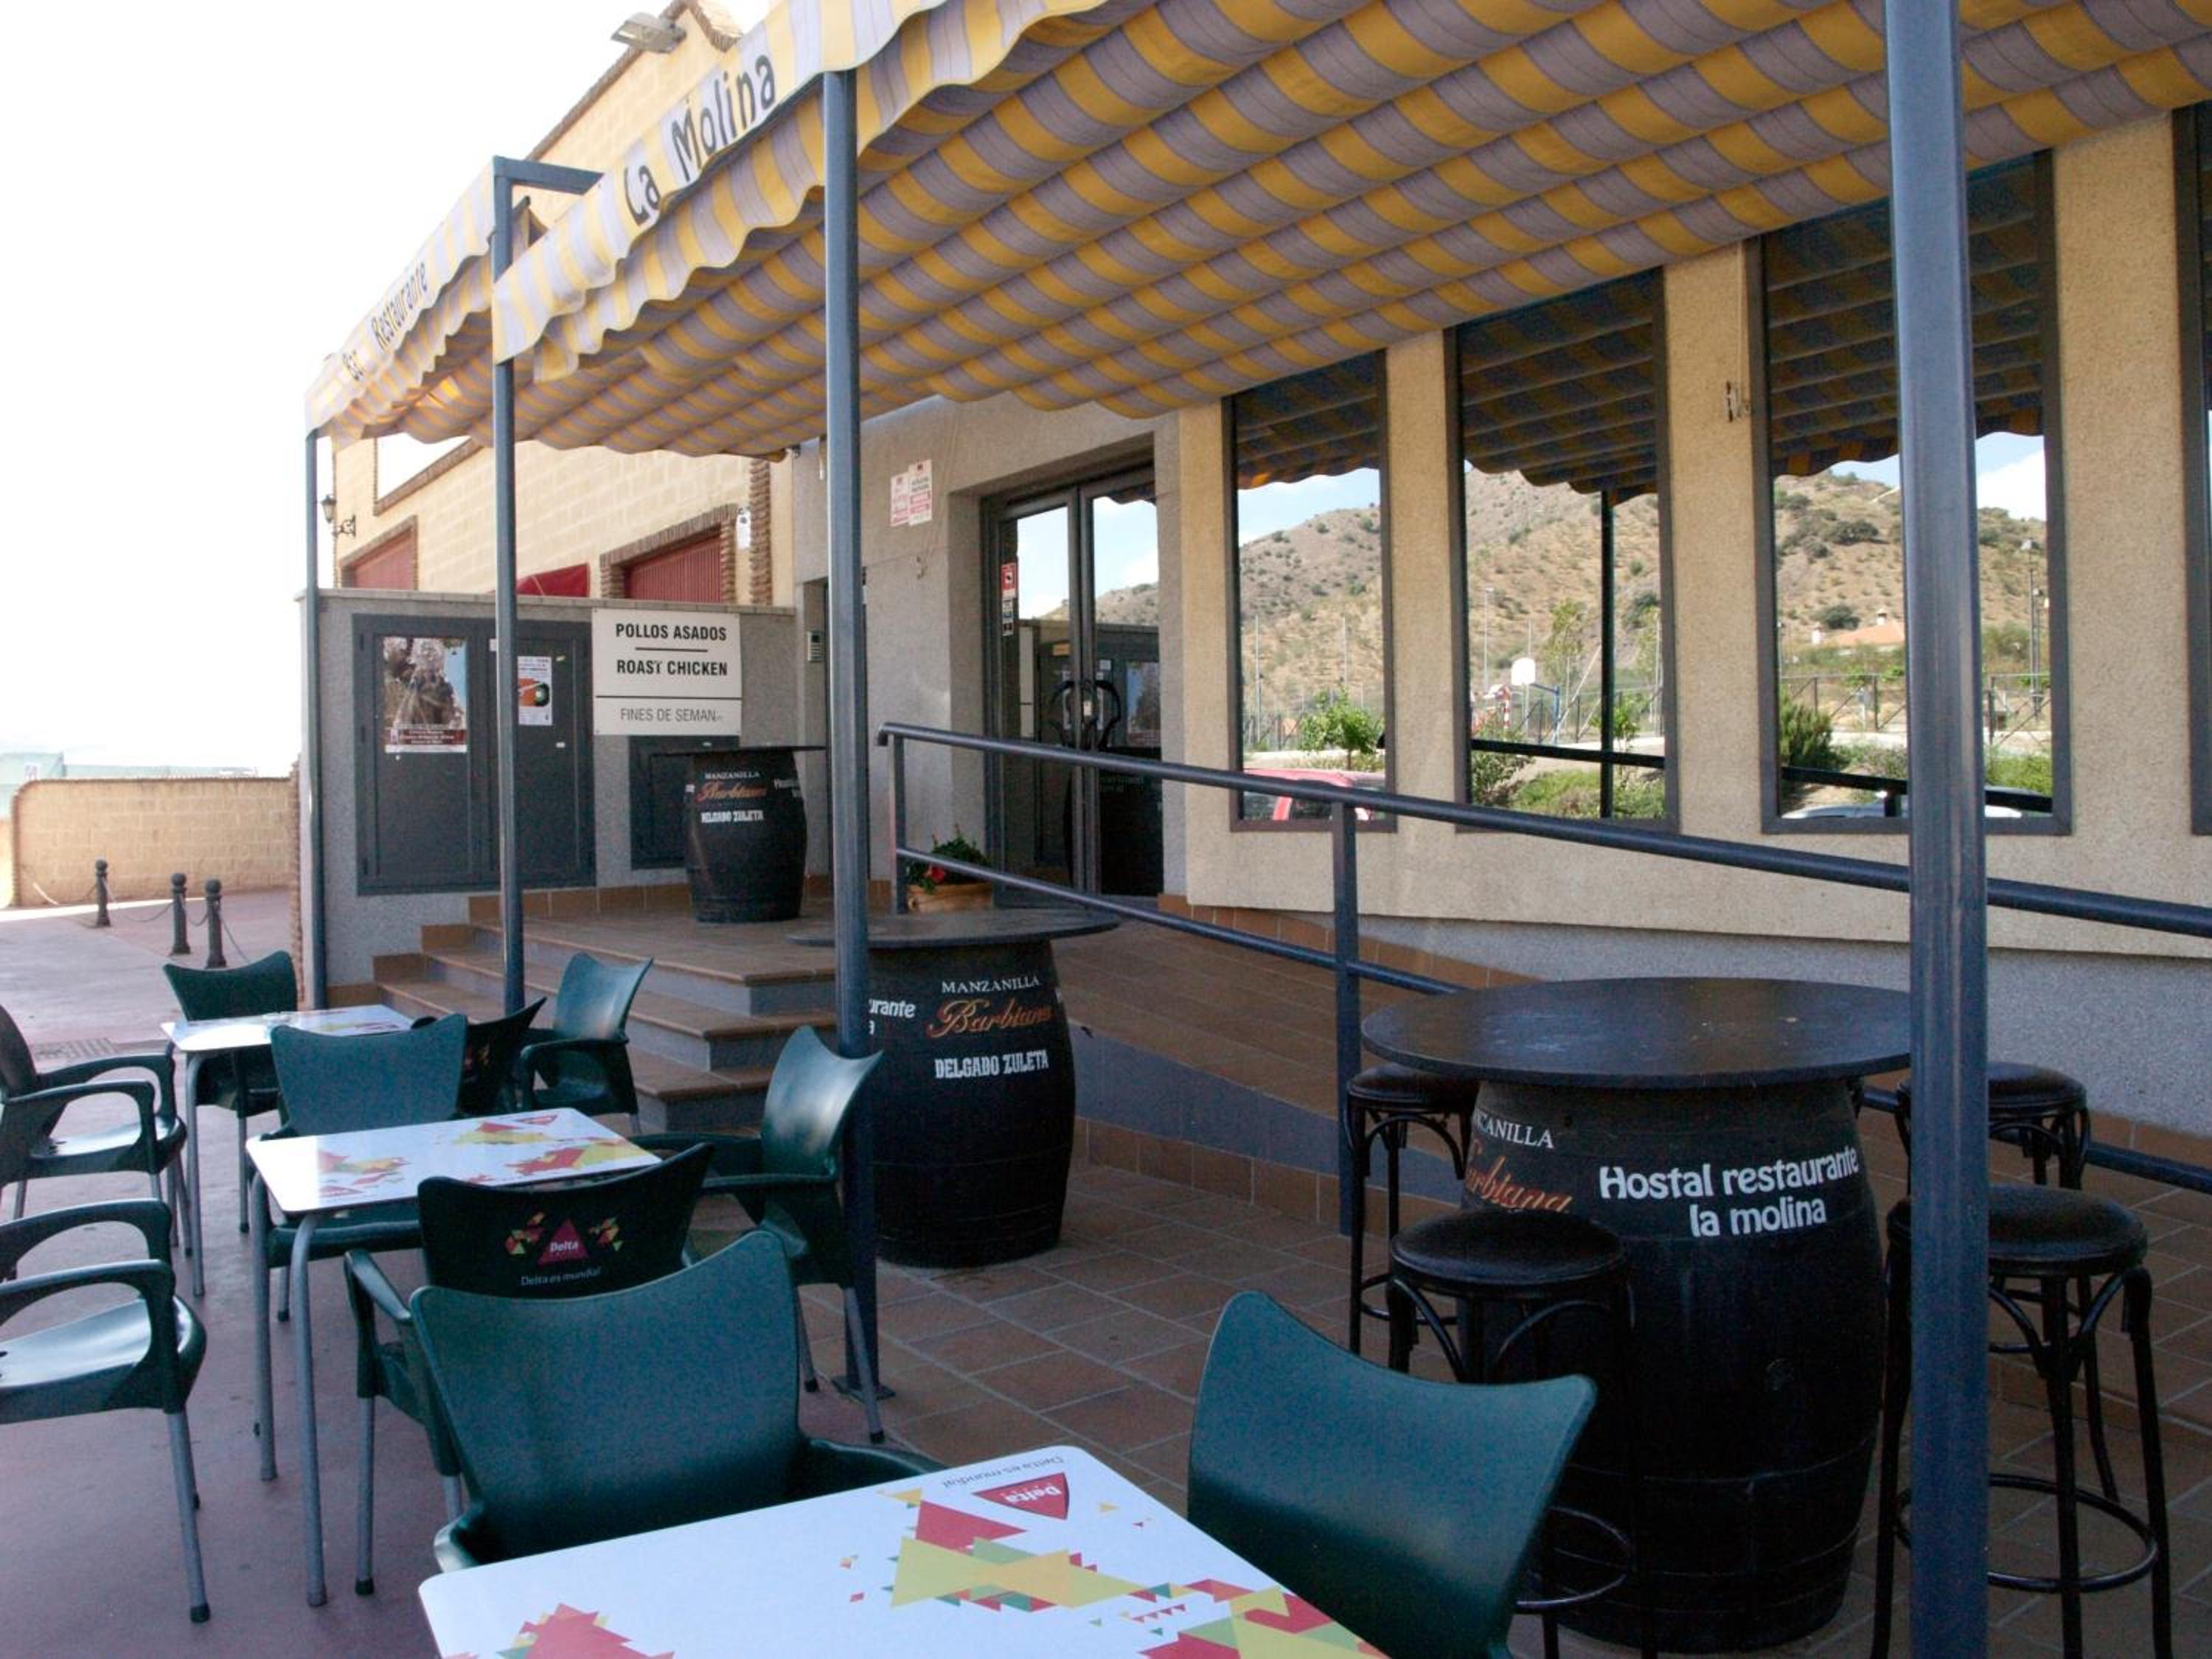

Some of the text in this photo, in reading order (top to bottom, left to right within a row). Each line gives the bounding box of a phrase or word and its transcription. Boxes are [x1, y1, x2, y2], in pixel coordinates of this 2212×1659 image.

[623, 55, 776, 226] La Molina
[370, 260, 428, 351] Restaurante
[615, 623, 728, 641] POLLOS ASADOS
[616, 659, 728, 676] ROAST CHICKEN
[619, 708, 654, 721] FINES
[657, 709, 672, 721] DE
[941, 975, 1041, 994] MANZANILLA
[934, 1049, 1050, 1079] DELGADO ZULETA
[1599, 1145, 1860, 1200] Hostal restaurante
[1689, 1195, 1827, 1238] la molina
[1004, 1485, 1062, 1503] Delta
